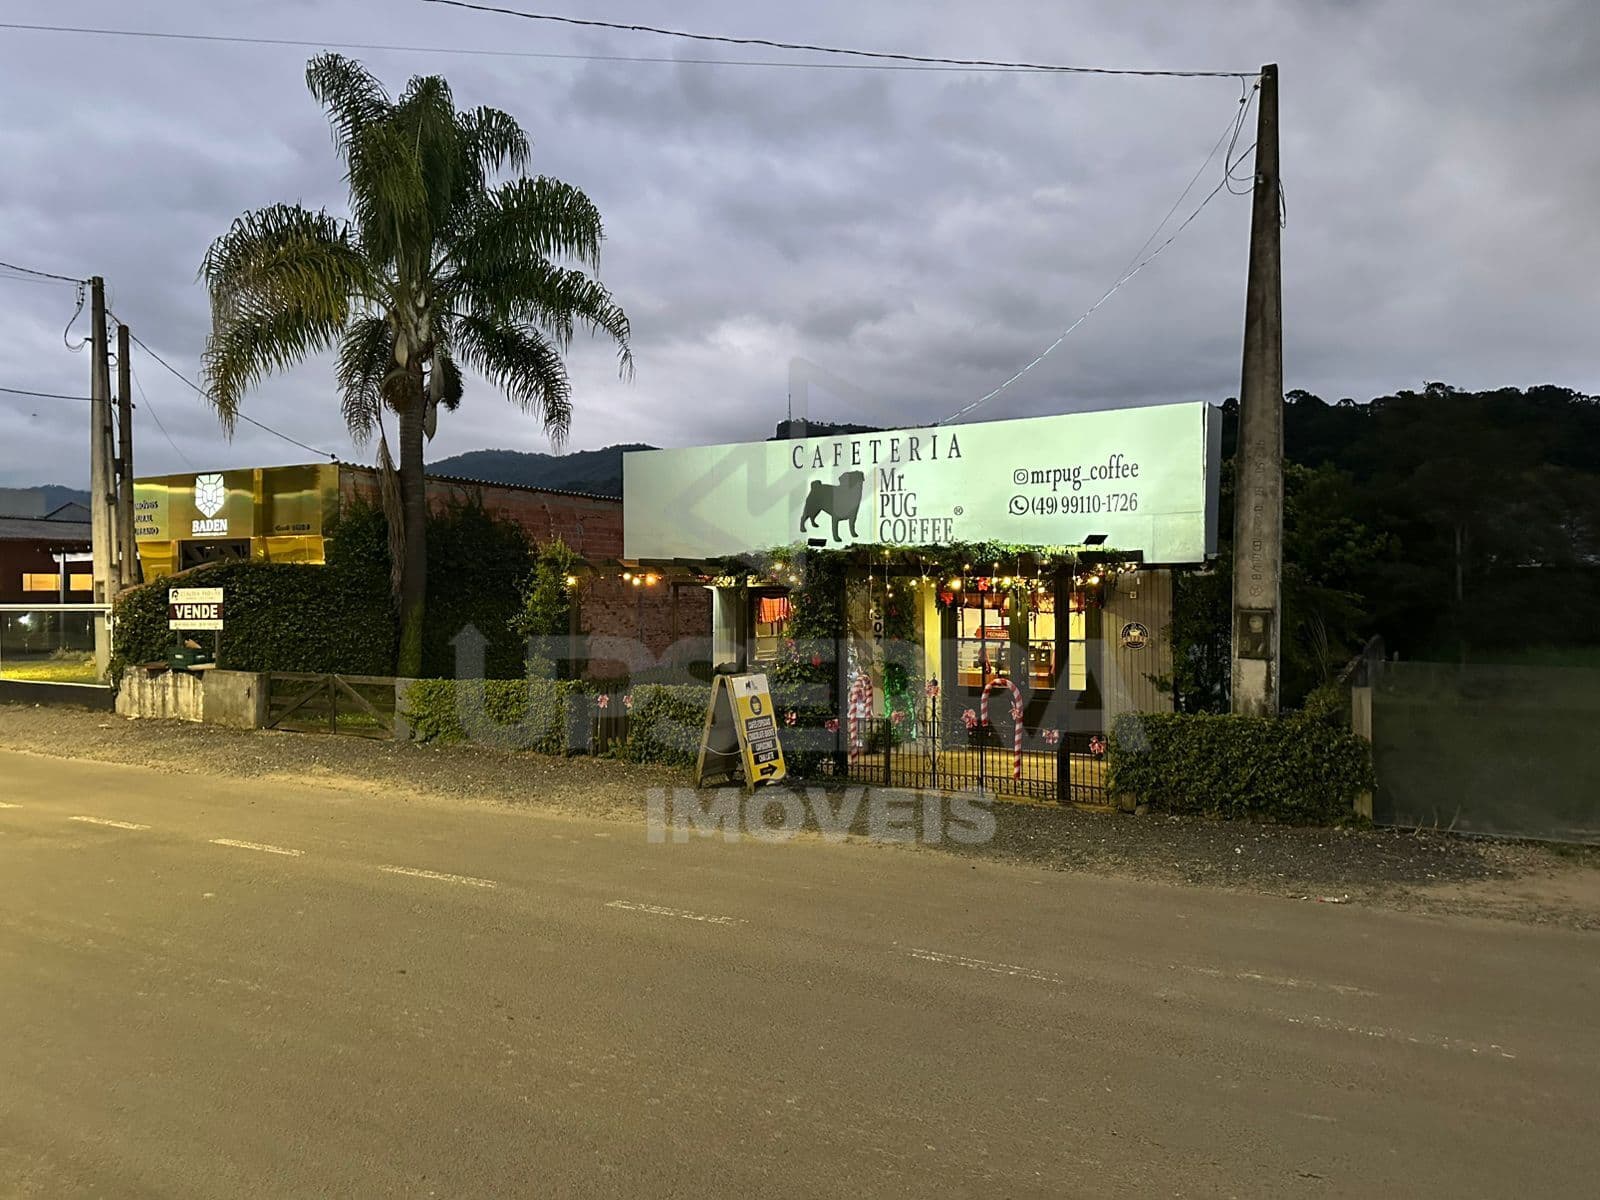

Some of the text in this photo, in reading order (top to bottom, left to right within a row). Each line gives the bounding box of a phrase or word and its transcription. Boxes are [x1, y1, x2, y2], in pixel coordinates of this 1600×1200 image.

[792, 433, 962, 469] CAFETERIA
[879, 467, 907, 493] Mr.
[1030, 453, 1139, 491] mrpug_coffee
[879, 493, 918, 518] PUG
[1031, 492, 1139, 516] (49) 99110-1726
[192, 518, 228, 533] BADEN
[879, 517, 955, 543] COFFEE
[174, 604, 218, 618] VENDE
